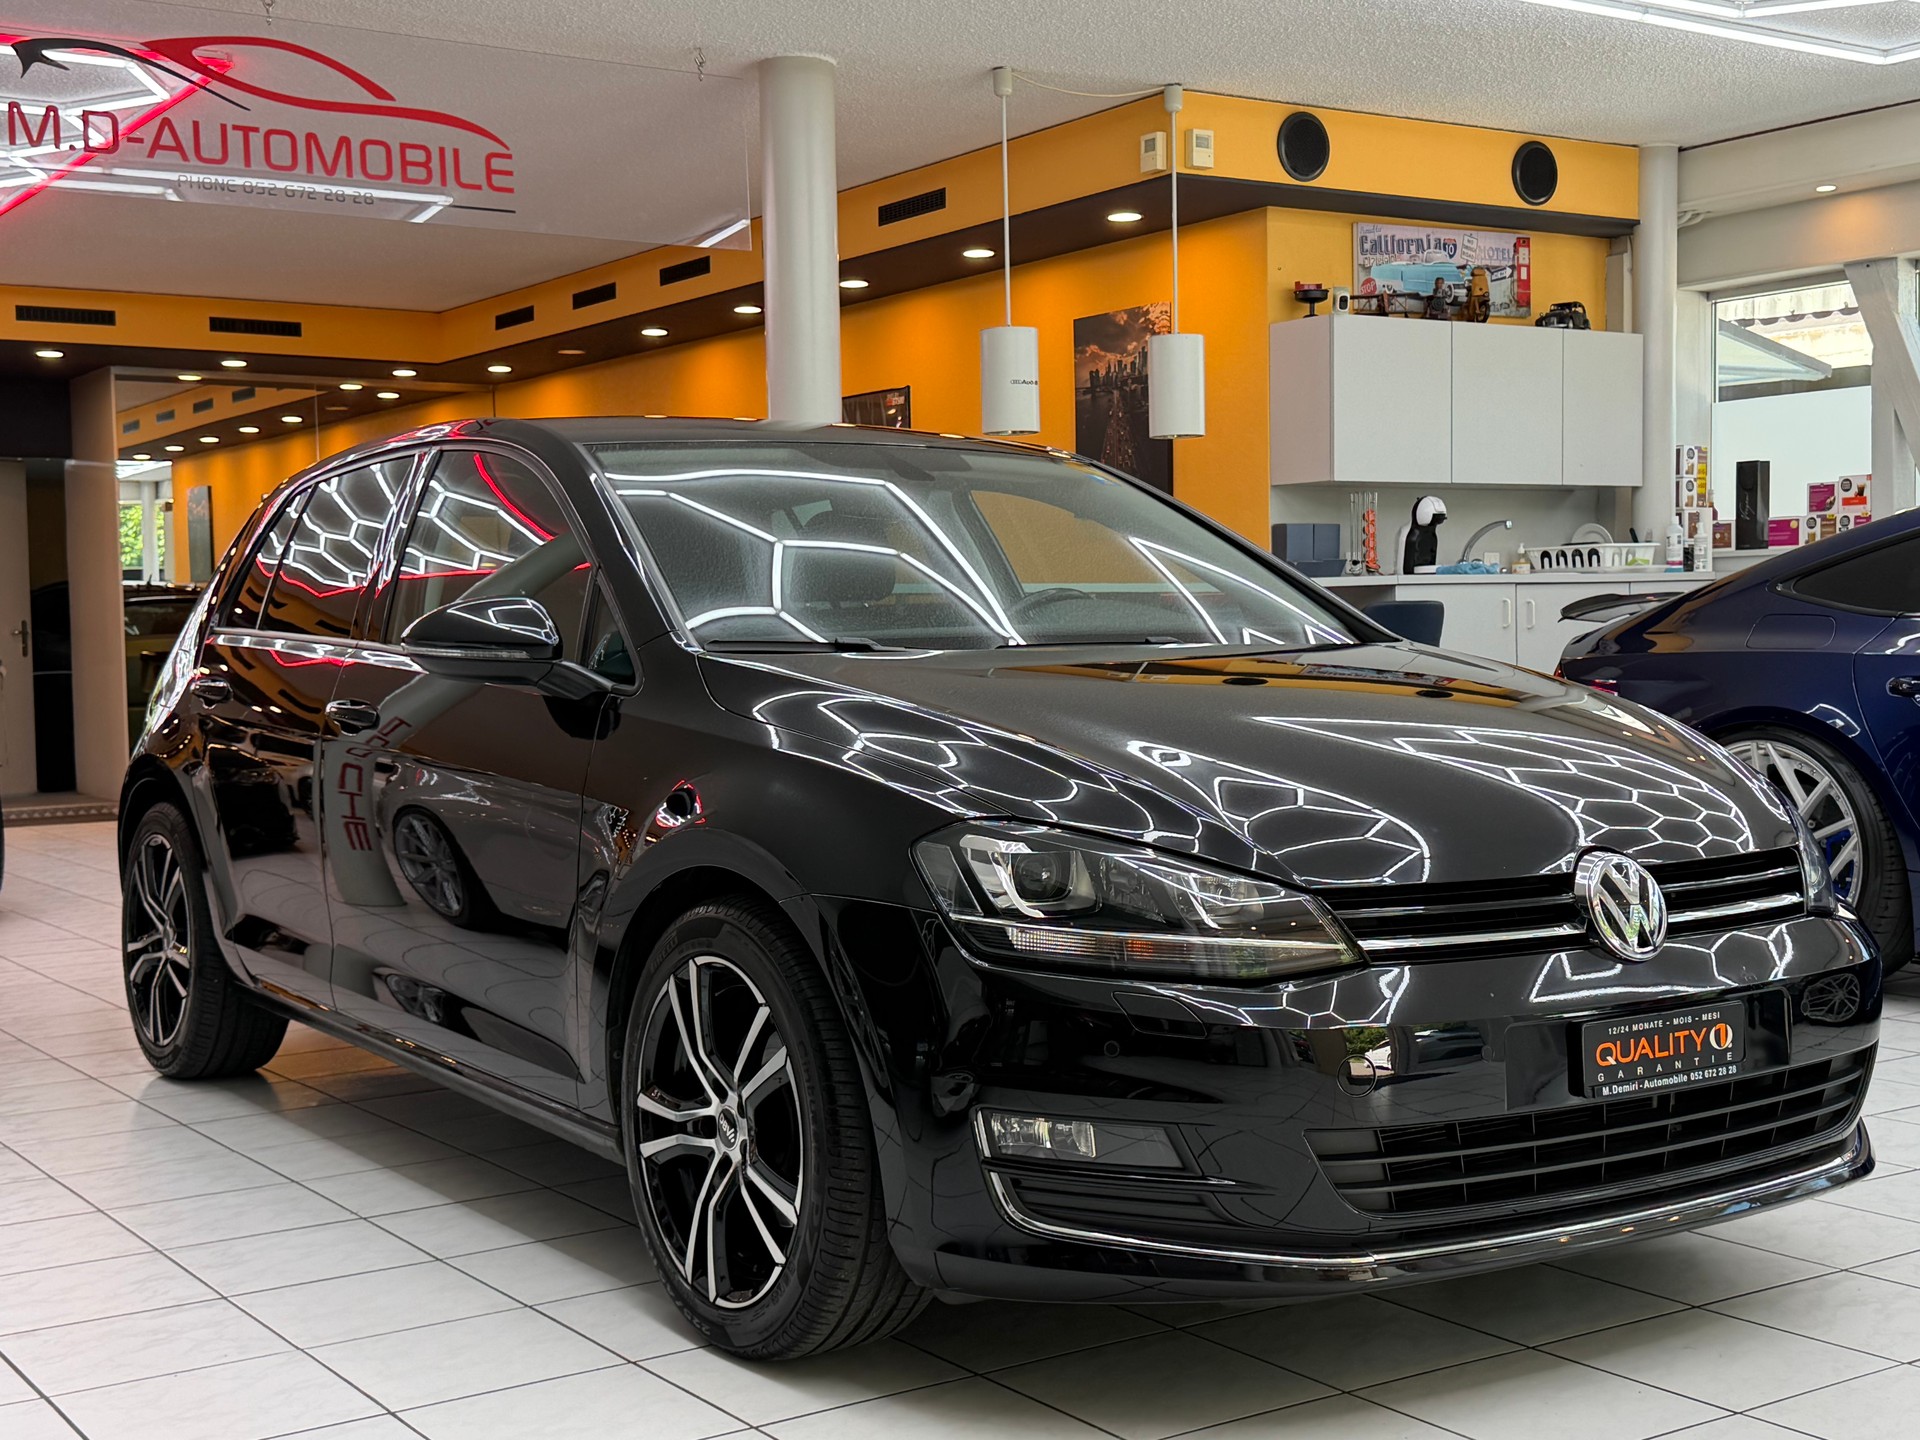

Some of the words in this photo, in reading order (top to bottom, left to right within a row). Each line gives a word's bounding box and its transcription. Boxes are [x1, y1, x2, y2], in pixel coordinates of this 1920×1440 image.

[8, 101, 515, 194] M.D-AUTOMOBILE
[177, 173, 237, 193] PHONE
[242, 180, 279, 197] 052
[284, 184, 318, 201] 672
[323, 188, 347, 204] 28
[352, 191, 375, 206] 28
[1359, 233, 1442, 256] California
[1445, 244, 1455, 256] 10
[1360, 281, 1377, 295] STOP
[1608, 1025, 1630, 1036] 12/24
[1632, 1021, 1663, 1032] MONATE
[1673, 1015, 1692, 1026] MOIS
[1702, 1011, 1720, 1022] MESI
[1595, 1027, 1708, 1067] QUALITY
[1597, 1051, 1733, 1083] GARANTIE
[1643, 1070, 1688, 1090] Automobile
[1690, 1071, 1703, 1082] 052
[1704, 1068, 1718, 1079] 672
[1718, 1066, 1727, 1076] 28
[1728, 1064, 1737, 1074] 28
